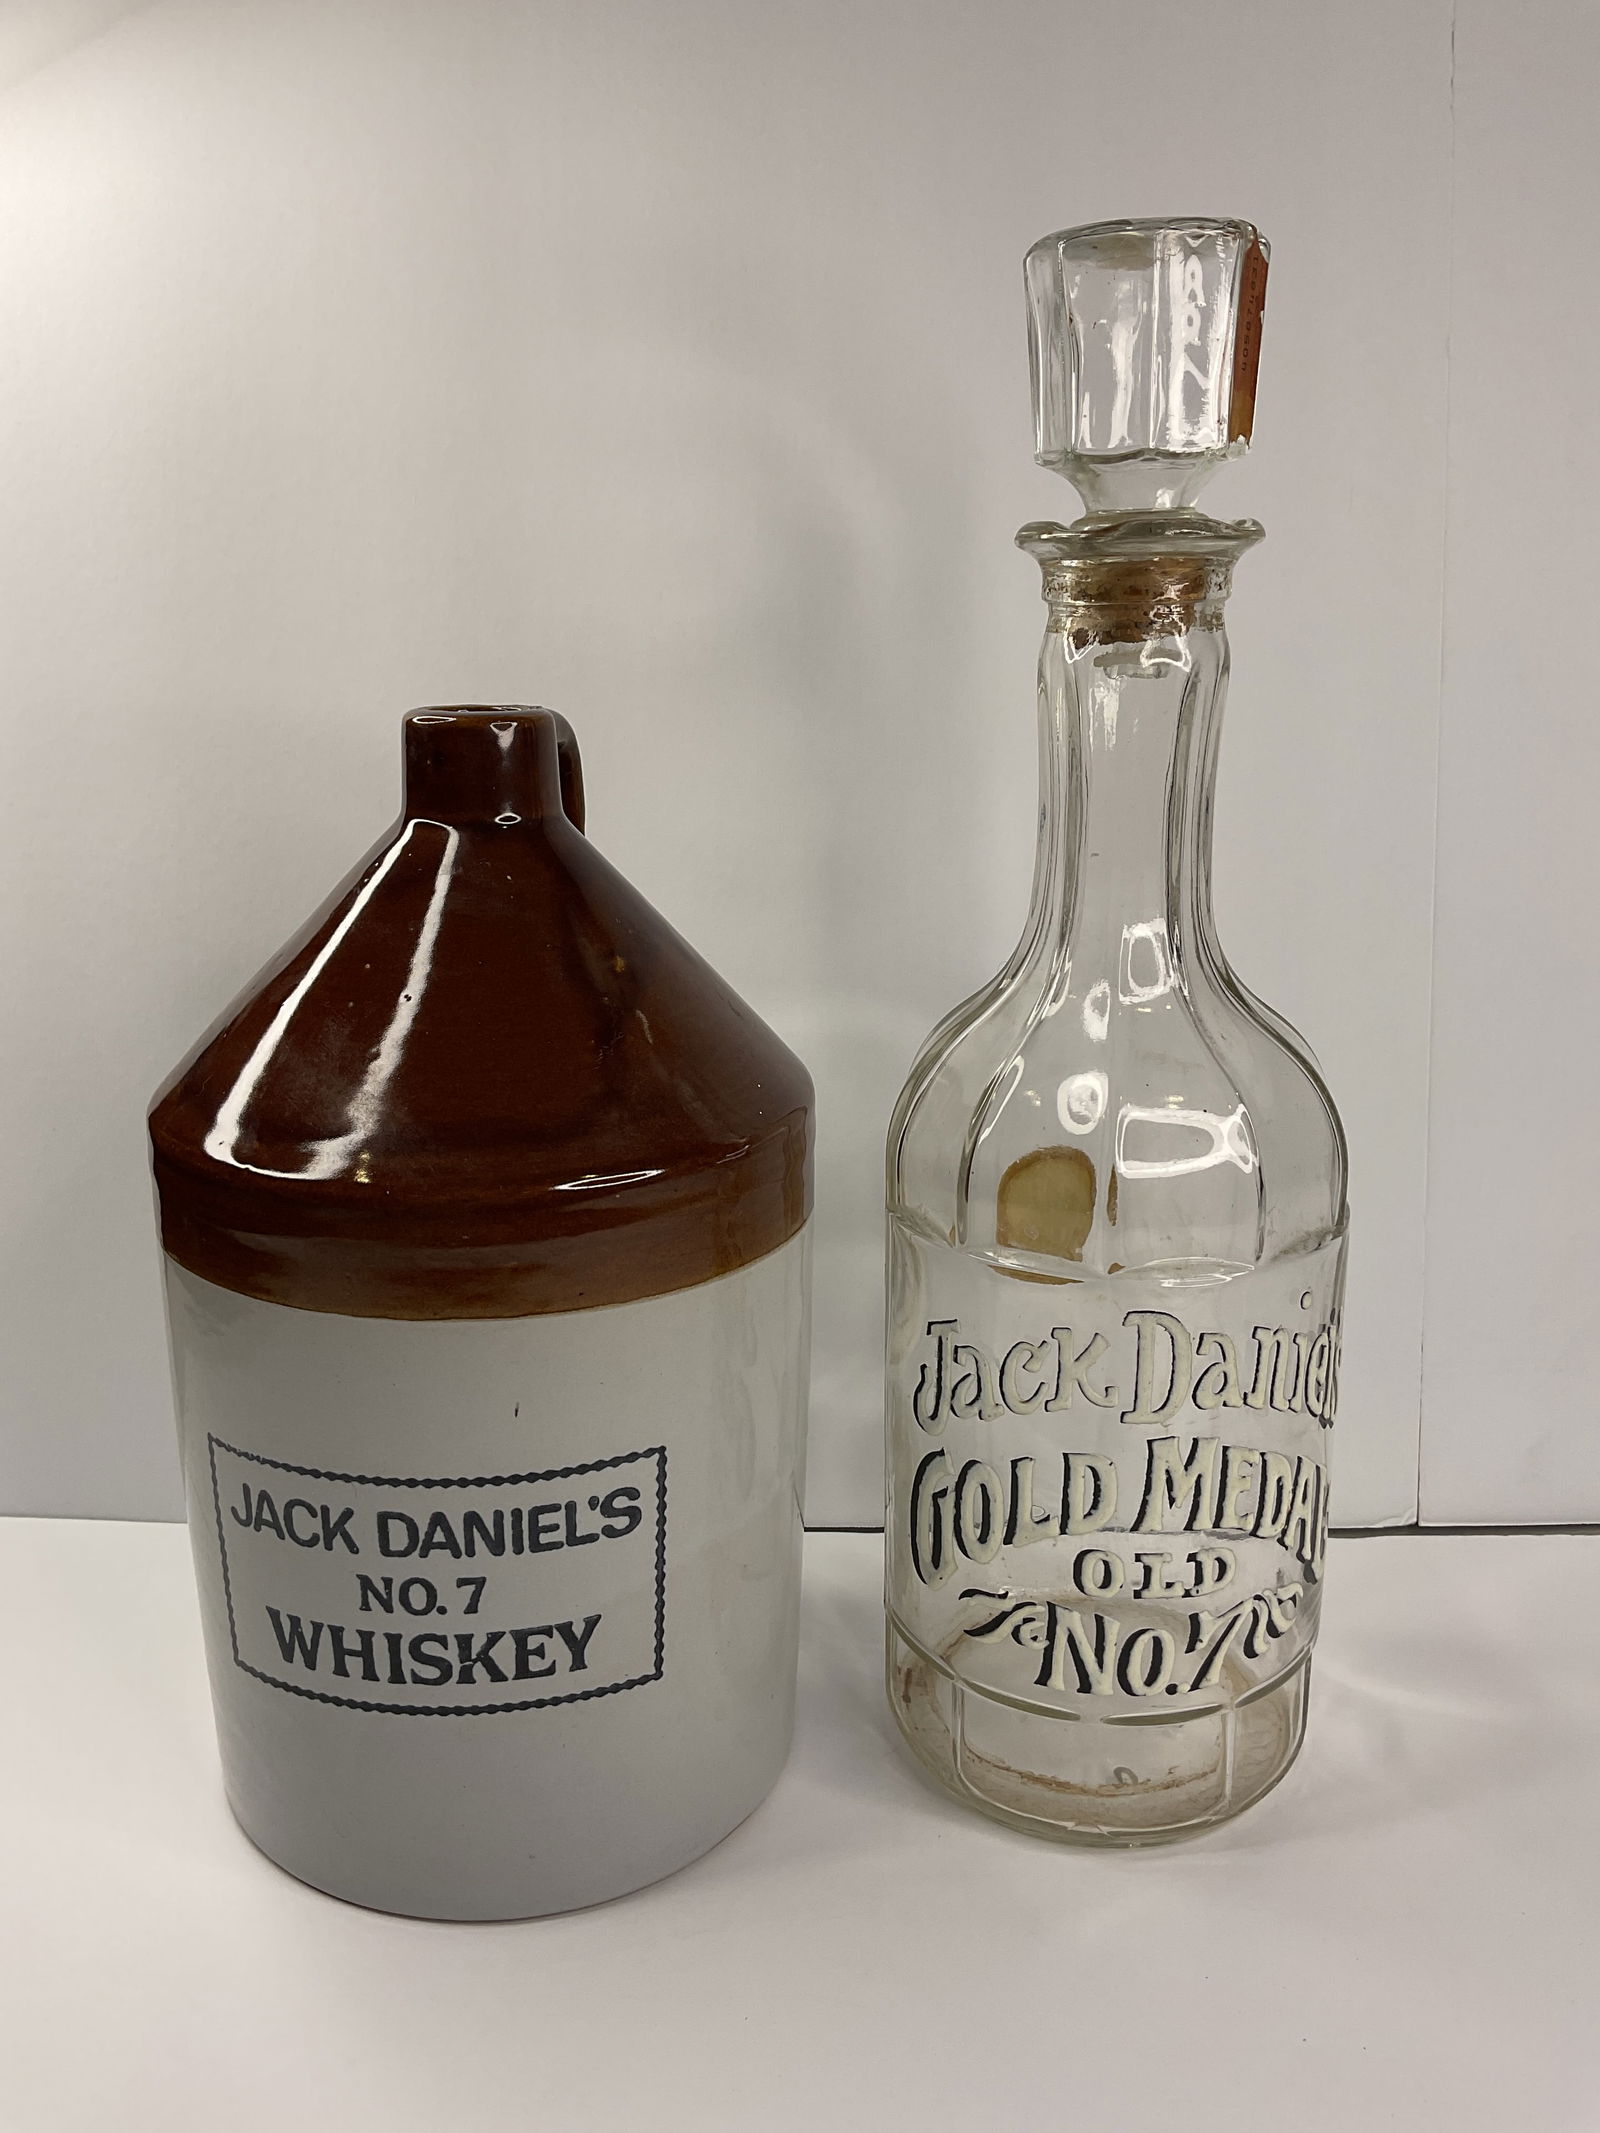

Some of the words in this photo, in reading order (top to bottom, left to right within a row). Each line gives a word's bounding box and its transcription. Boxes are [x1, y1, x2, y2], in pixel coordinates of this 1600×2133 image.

[912, 1318, 1119, 1436] Jack
[230, 1483, 359, 1555] JACK
[376, 1486, 643, 1559] DANIEL'S
[910, 1447, 1120, 1590] GOLD
[1072, 1547, 1236, 1599] OLD
[264, 1604, 602, 1687] WHISKEY
